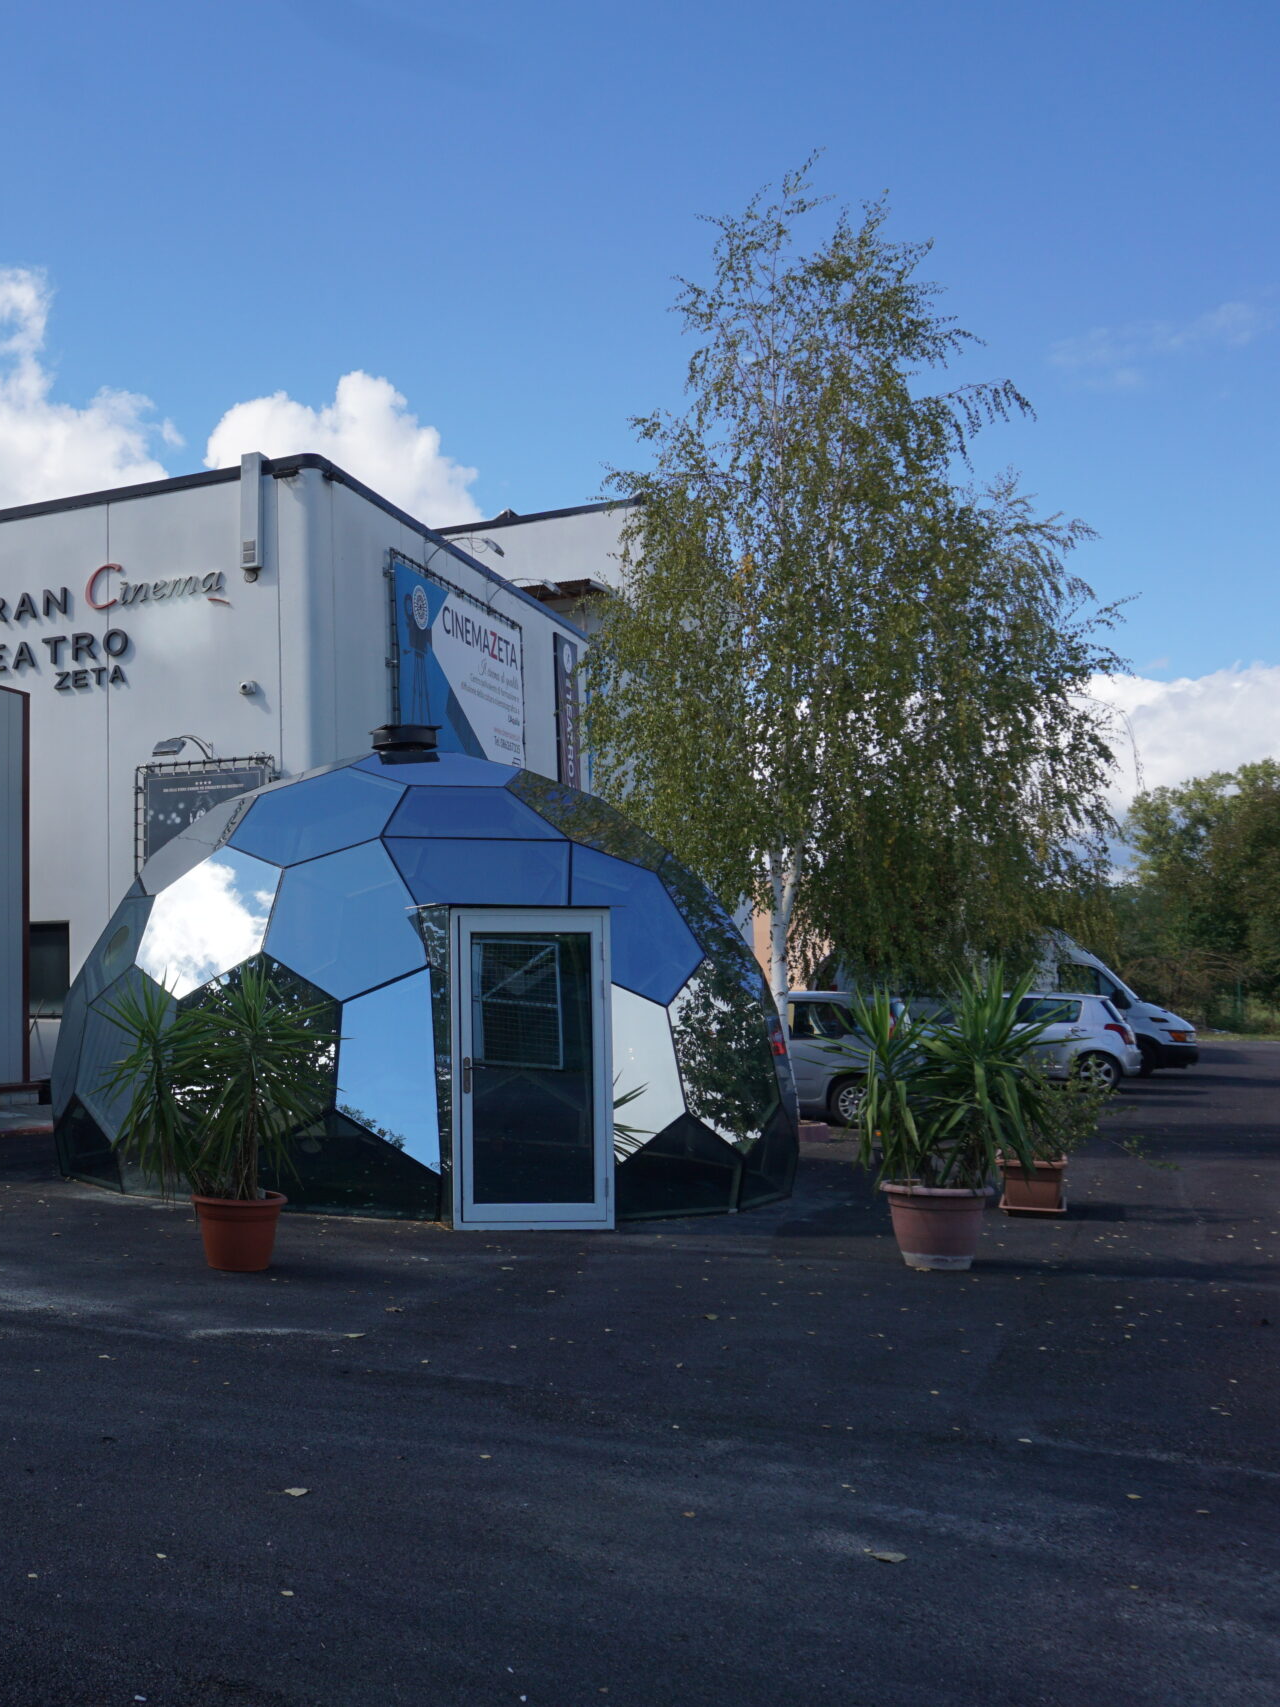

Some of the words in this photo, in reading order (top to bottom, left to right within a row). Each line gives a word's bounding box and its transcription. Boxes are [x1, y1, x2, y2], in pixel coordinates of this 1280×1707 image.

[85, 563, 225, 610] Cinema
[442, 605, 518, 671] CINEMAZETA
[54, 665, 126, 690] ZETA
